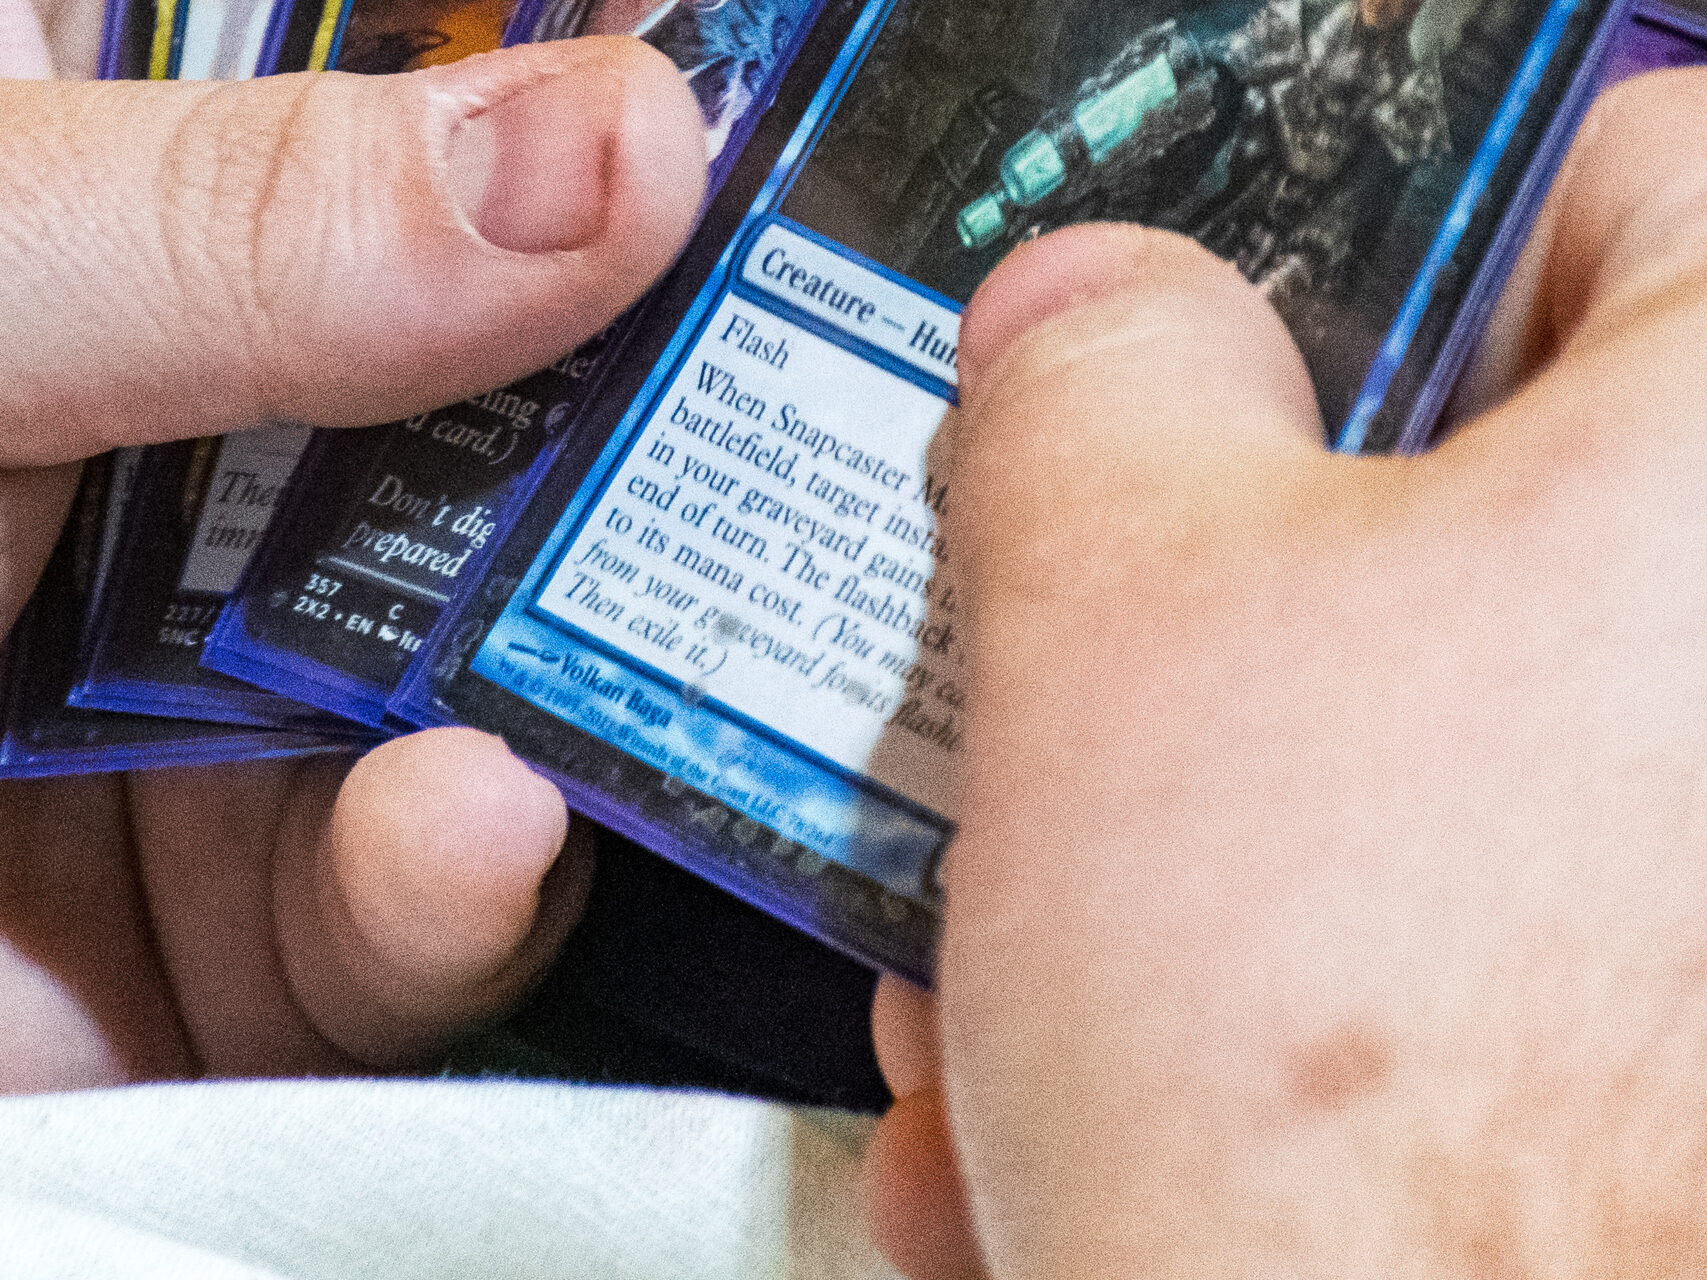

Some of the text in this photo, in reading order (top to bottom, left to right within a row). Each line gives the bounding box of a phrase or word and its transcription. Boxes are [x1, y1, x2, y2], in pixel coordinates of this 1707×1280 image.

[761, 247, 877, 323] Creature
[720, 312, 790, 370] Flash
[432, 420, 520, 466] card.)
[669, 395, 800, 488] battlefield,
[805, 471, 881, 524] target
[695, 360, 767, 422] When
[770, 402, 912, 493] Snapcaster
[368, 474, 497, 549] Don't dig
[627, 473, 681, 512] end
[680, 500, 718, 529] of
[712, 515, 770, 565] turn.
[778, 540, 832, 591] The
[647, 430, 676, 467] in
[675, 451, 740, 498] your
[737, 485, 870, 563] graveyard
[304, 572, 343, 598] 357
[340, 521, 474, 578] prepared
[574, 537, 642, 586] from
[633, 571, 699, 614] your
[604, 504, 632, 535] to
[637, 521, 670, 554] its
[672, 541, 745, 595] mana
[748, 581, 802, 626] cost.
[811, 612, 877, 661] (You
[293, 595, 332, 621] 2X2
[562, 570, 728, 679] Then exile it.)
[560, 651, 626, 705] Volkan
